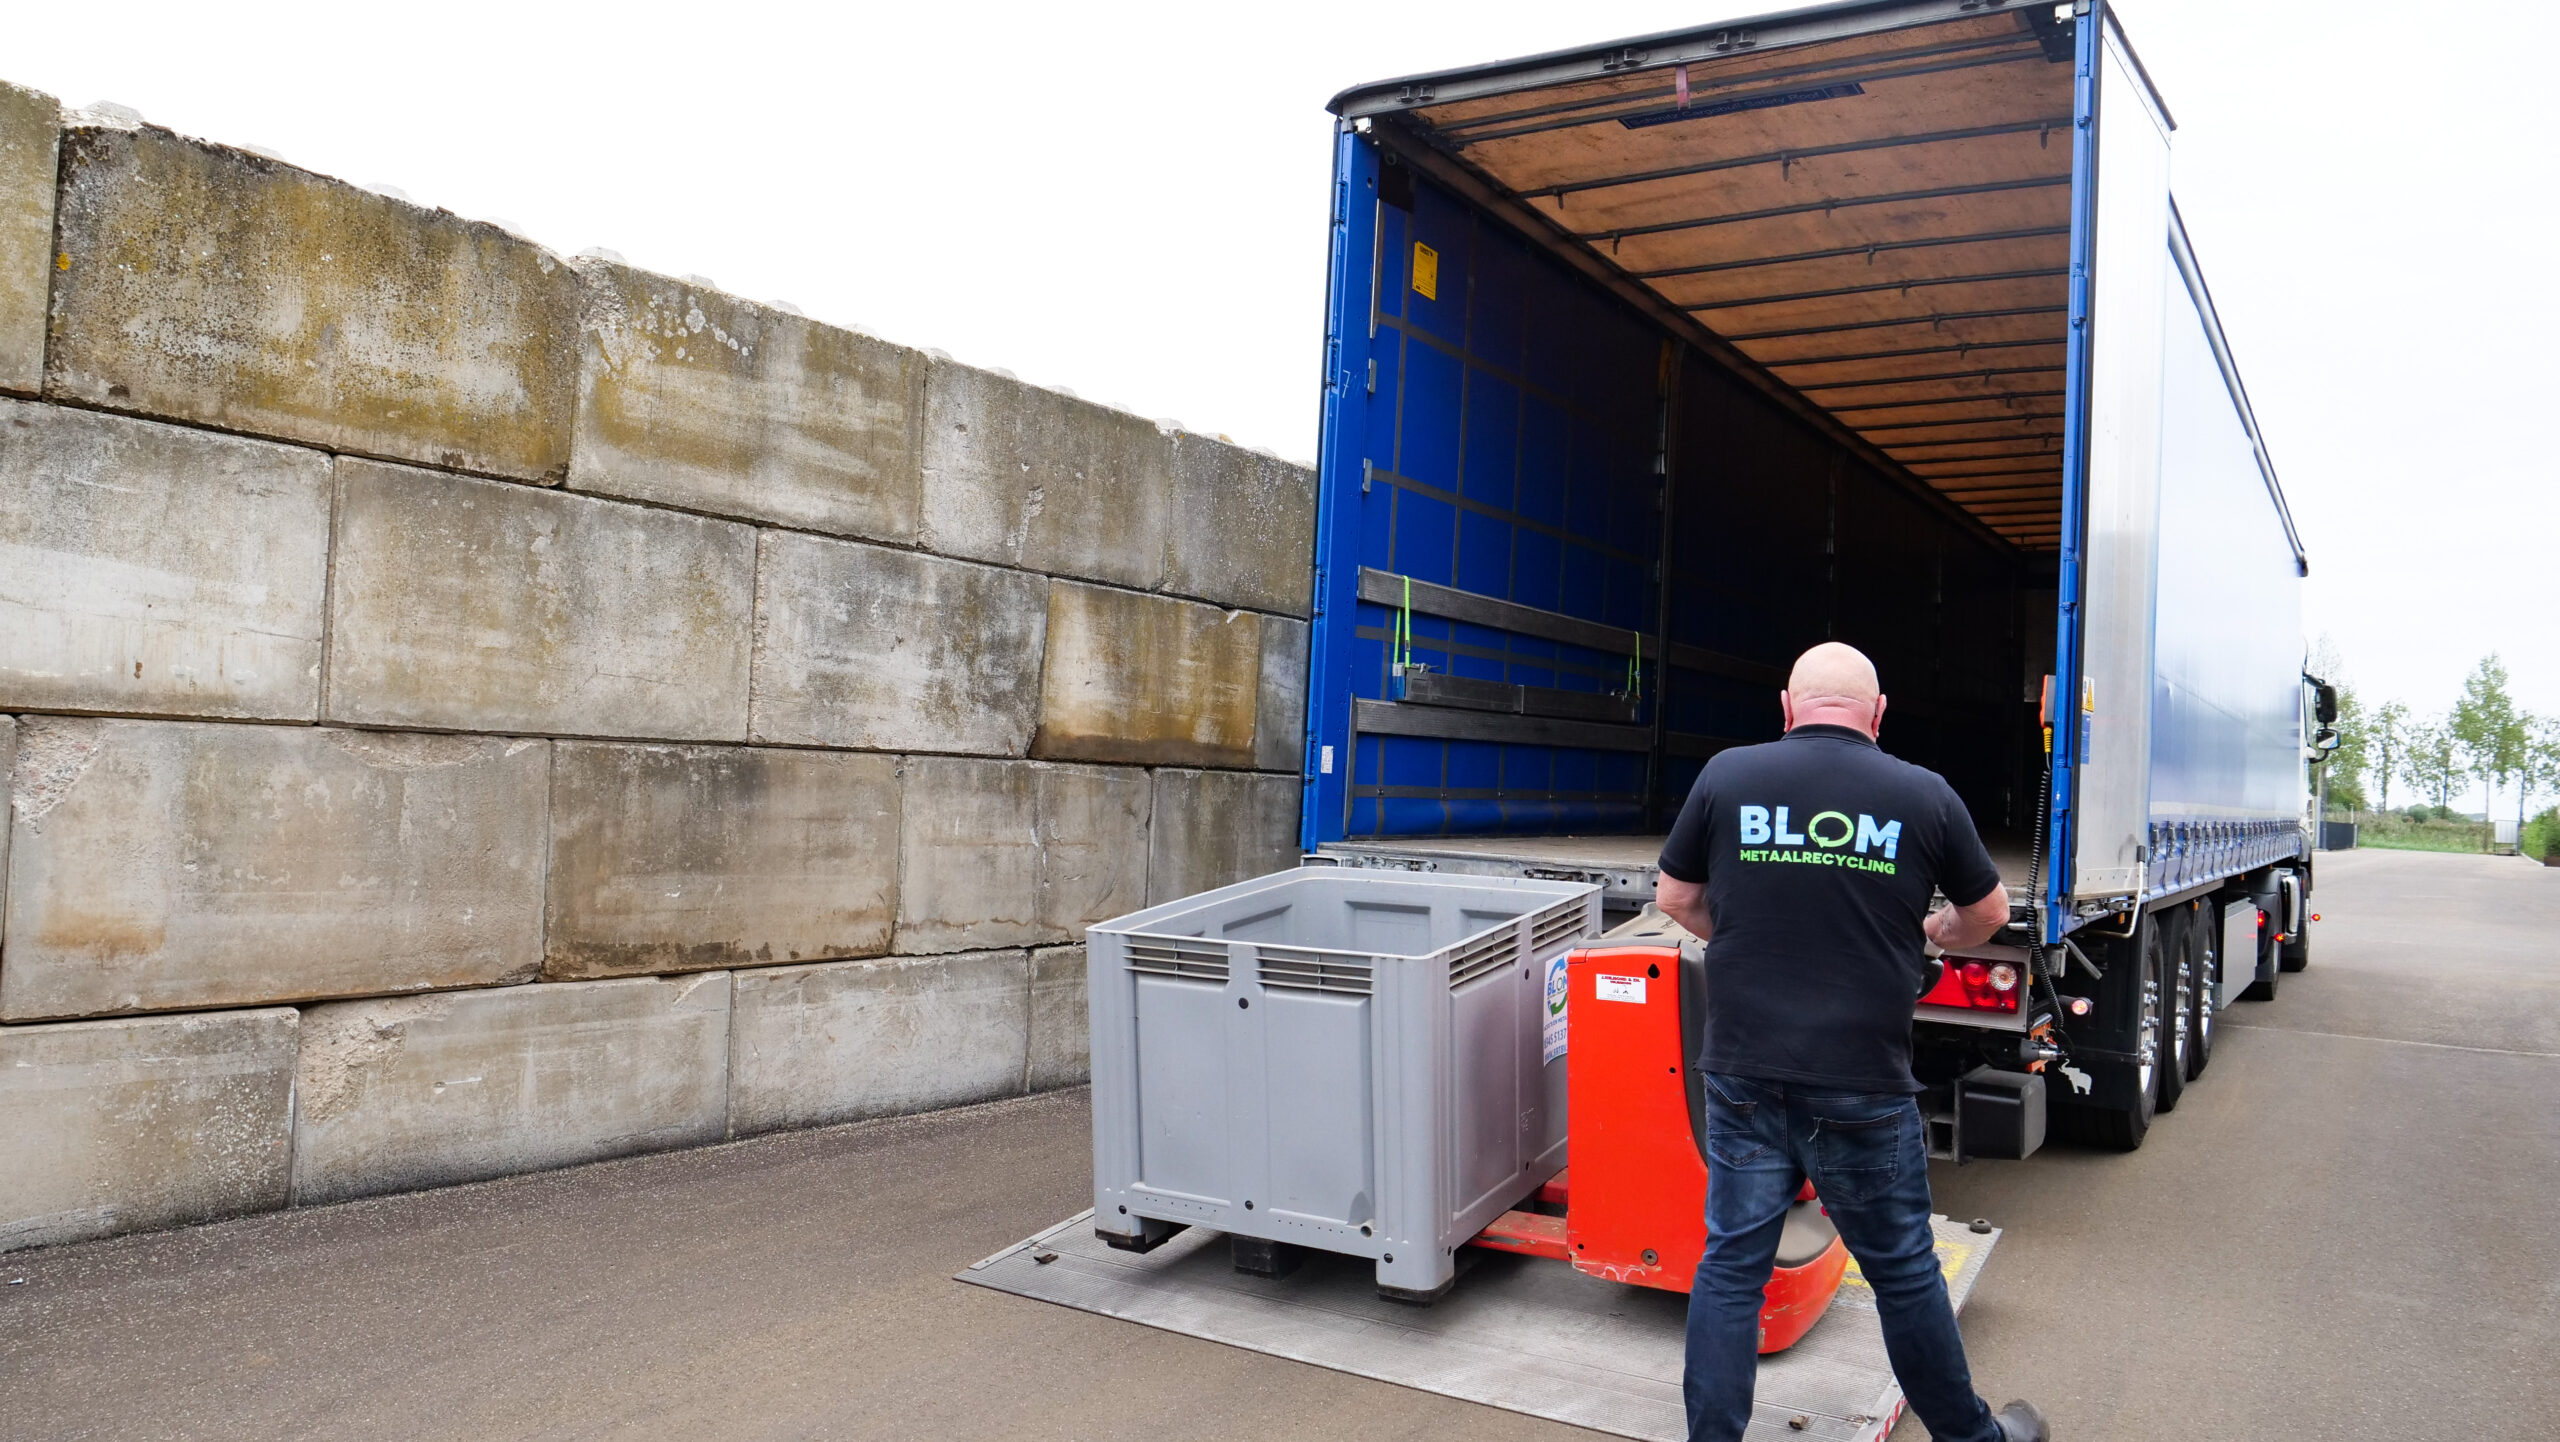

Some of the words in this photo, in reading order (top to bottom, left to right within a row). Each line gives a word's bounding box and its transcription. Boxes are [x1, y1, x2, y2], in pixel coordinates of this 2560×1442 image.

[1630, 112, 1678, 126] Schmitz
[1681, 101, 1742, 119] Cargobull
[1745, 96, 1785, 110] Safety
[1787, 91, 1820, 103] Roof
[1740, 805, 1902, 859] BLOM
[1740, 849, 1896, 875] METAALRECYCLING
